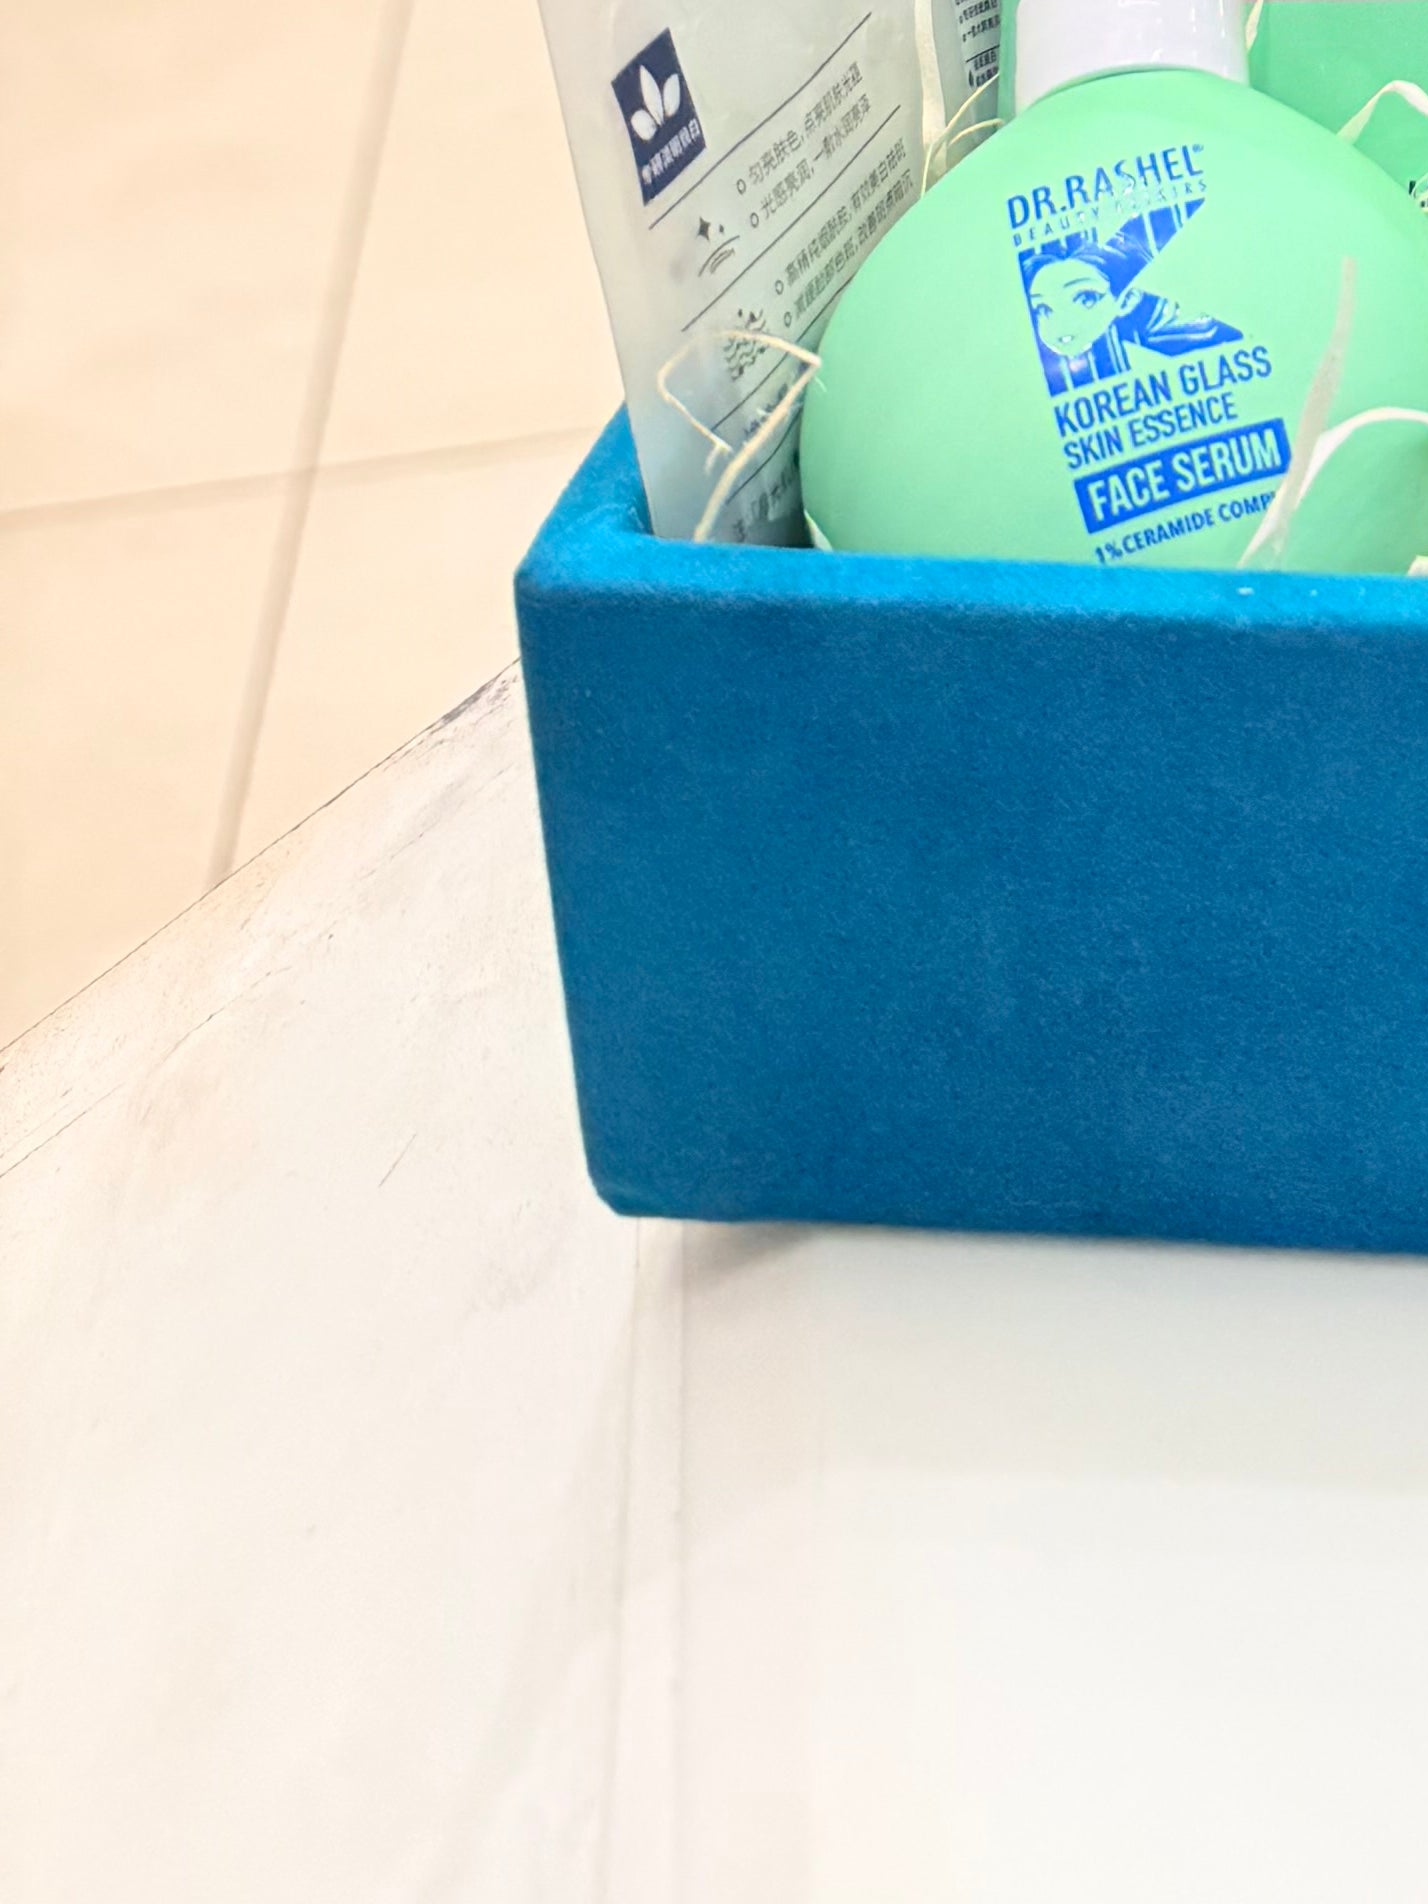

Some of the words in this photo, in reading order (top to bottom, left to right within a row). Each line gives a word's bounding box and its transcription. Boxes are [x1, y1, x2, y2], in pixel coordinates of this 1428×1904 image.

[1053, 369, 1173, 439] KOREAN
[1178, 345, 1274, 397] GLASS
[1063, 426, 1124, 471] SKIN
[1129, 392, 1239, 447] ESSENCE
[1086, 465, 1171, 522] FACE
[1173, 428, 1283, 492] SERUM
[1095, 532, 1124, 565] 1%
[1121, 506, 1216, 561] CERAMIDE
